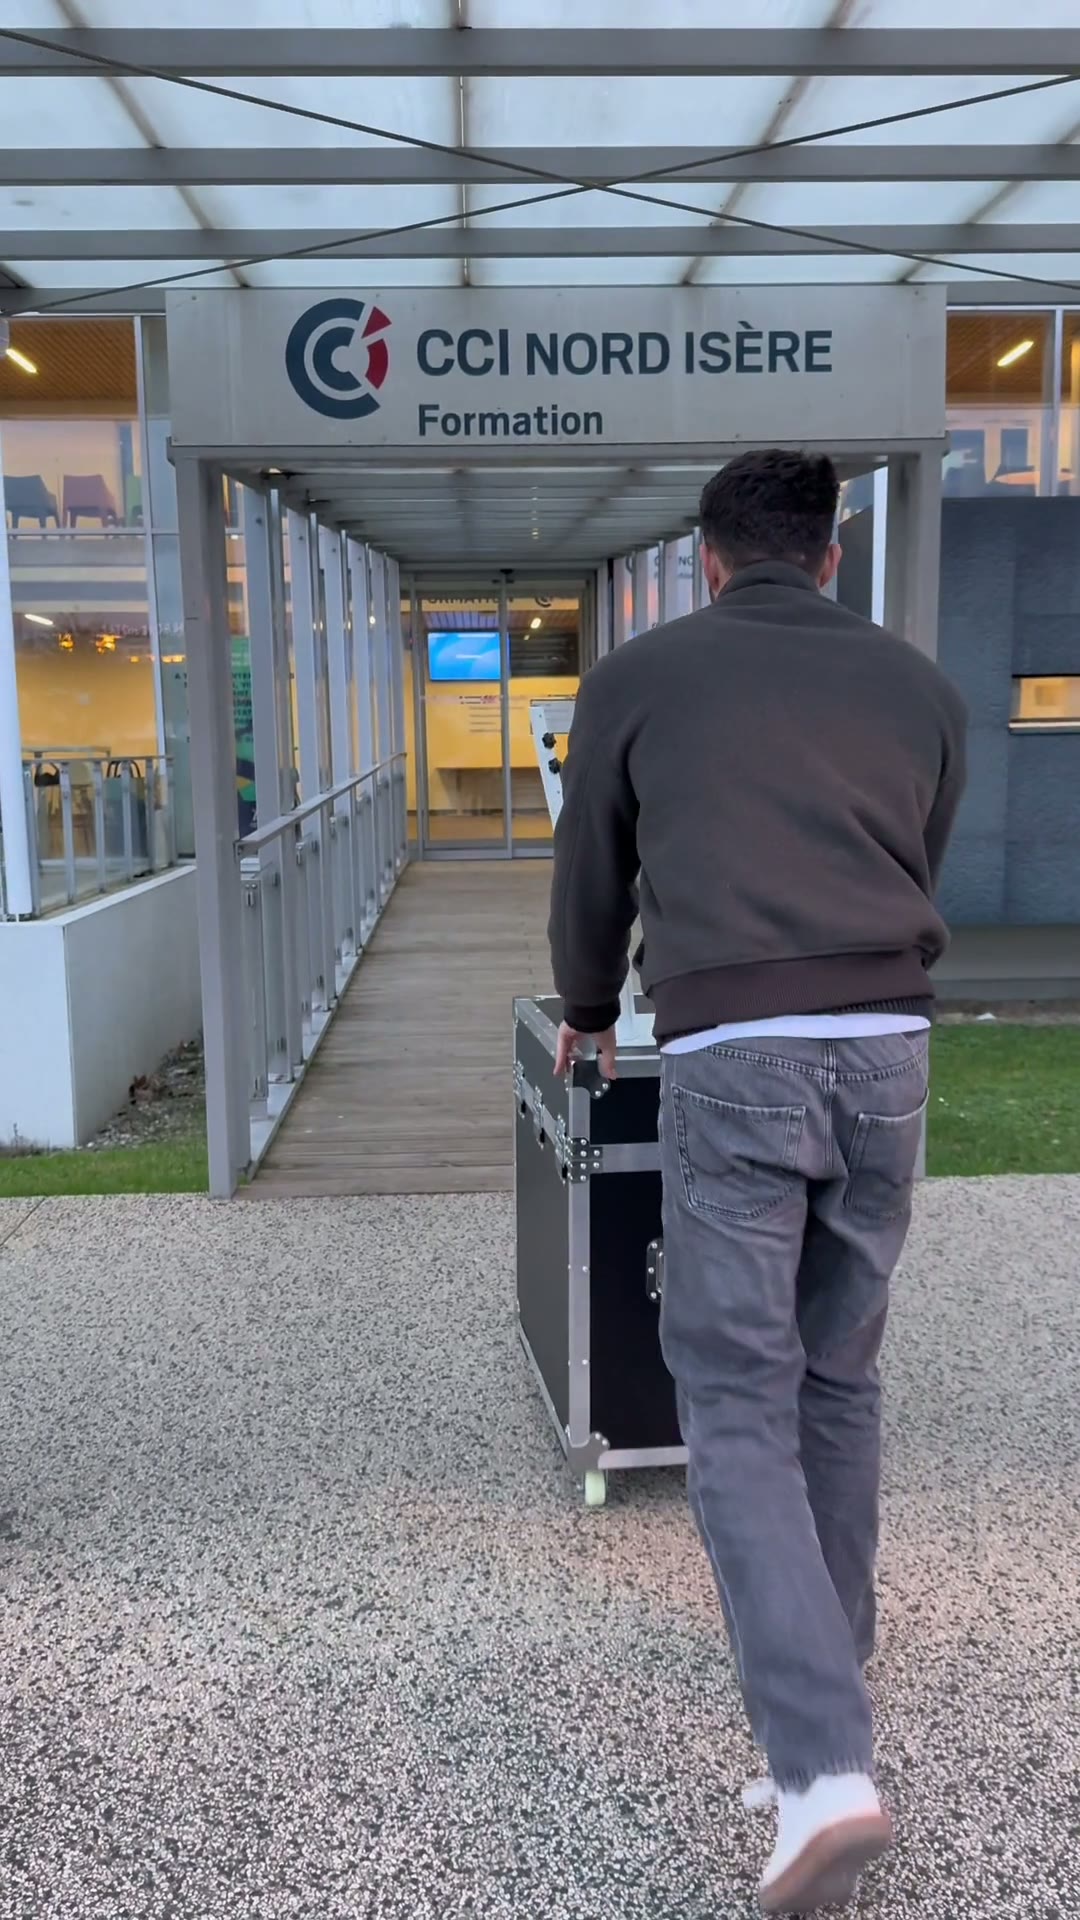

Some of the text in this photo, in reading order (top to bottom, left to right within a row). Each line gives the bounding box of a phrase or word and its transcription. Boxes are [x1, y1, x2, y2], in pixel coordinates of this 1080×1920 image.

[416, 320, 833, 377] CCI NORD ISÈRE
[417, 403, 604, 438] Formation
